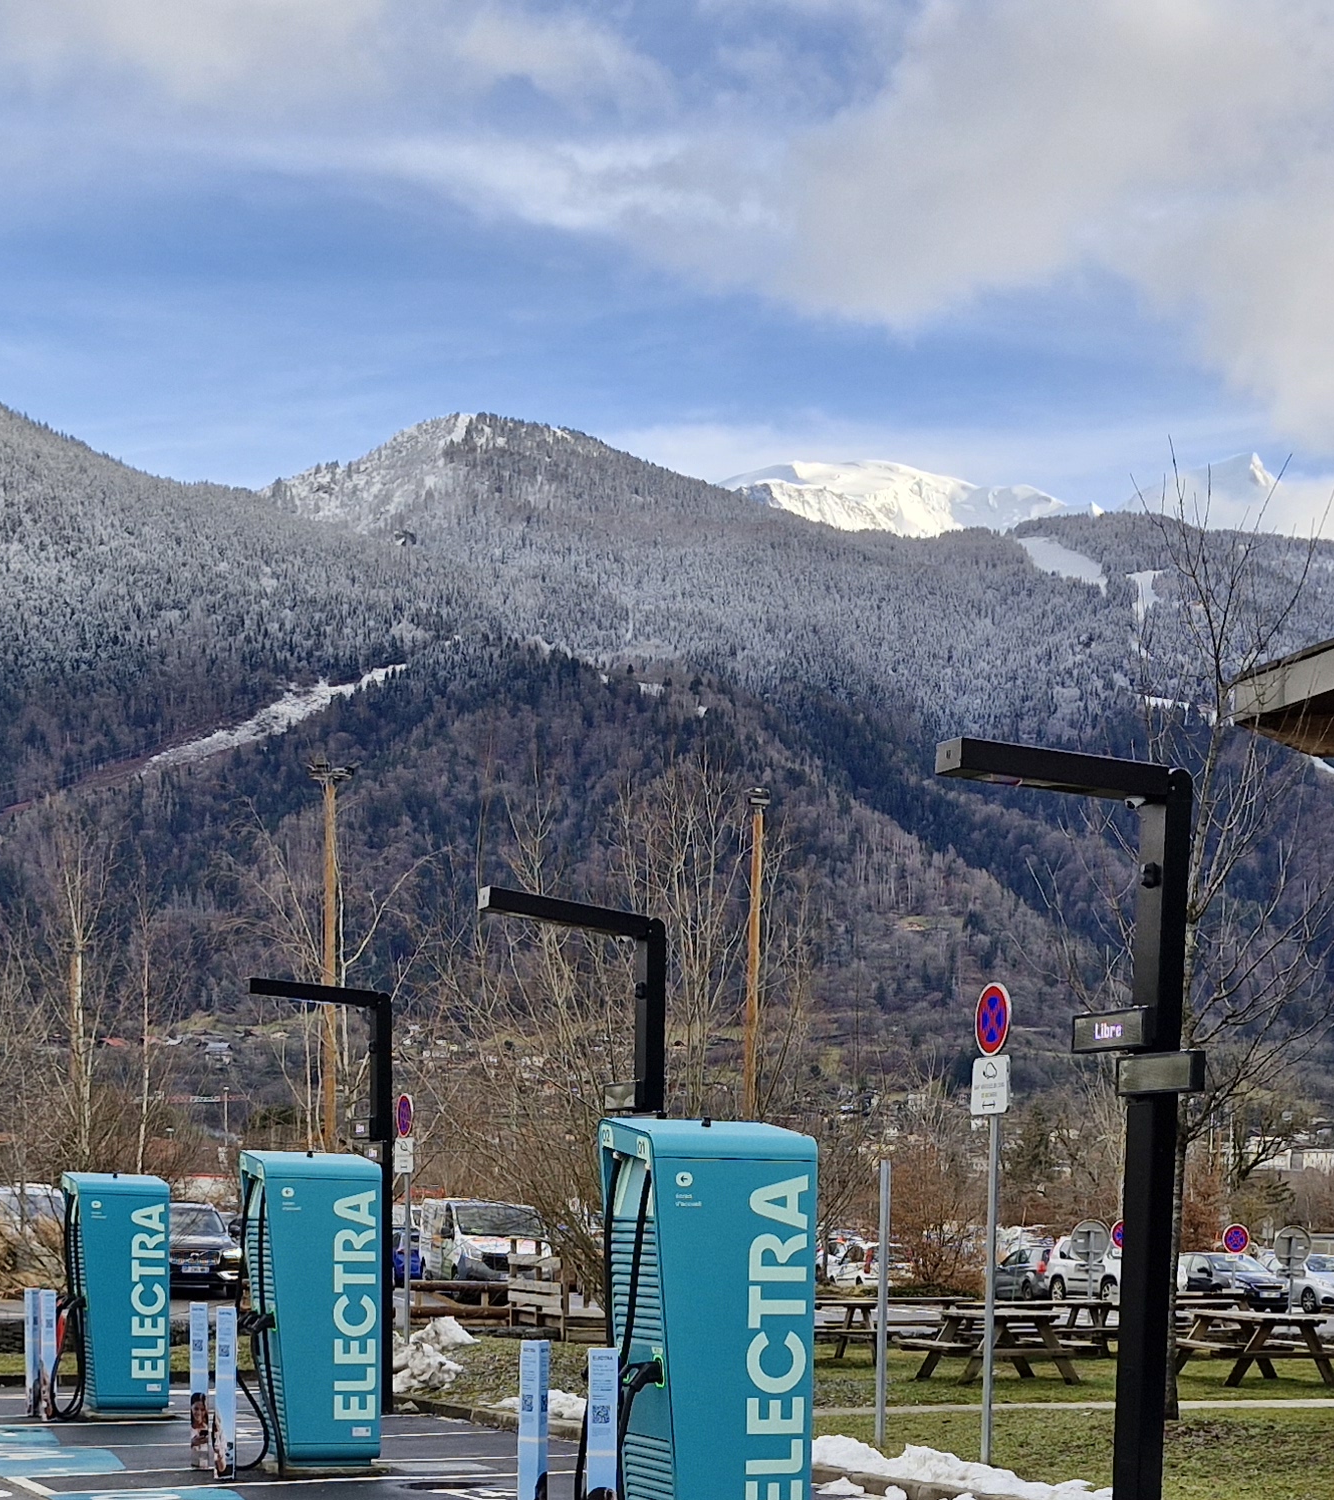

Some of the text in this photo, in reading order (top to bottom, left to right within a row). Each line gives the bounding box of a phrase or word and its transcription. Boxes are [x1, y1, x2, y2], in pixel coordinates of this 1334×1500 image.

[1094, 1022, 1123, 1040] Libre
[131, 1203, 166, 1379] ELECTRA
[333, 1189, 377, 1421] ELECTRA
